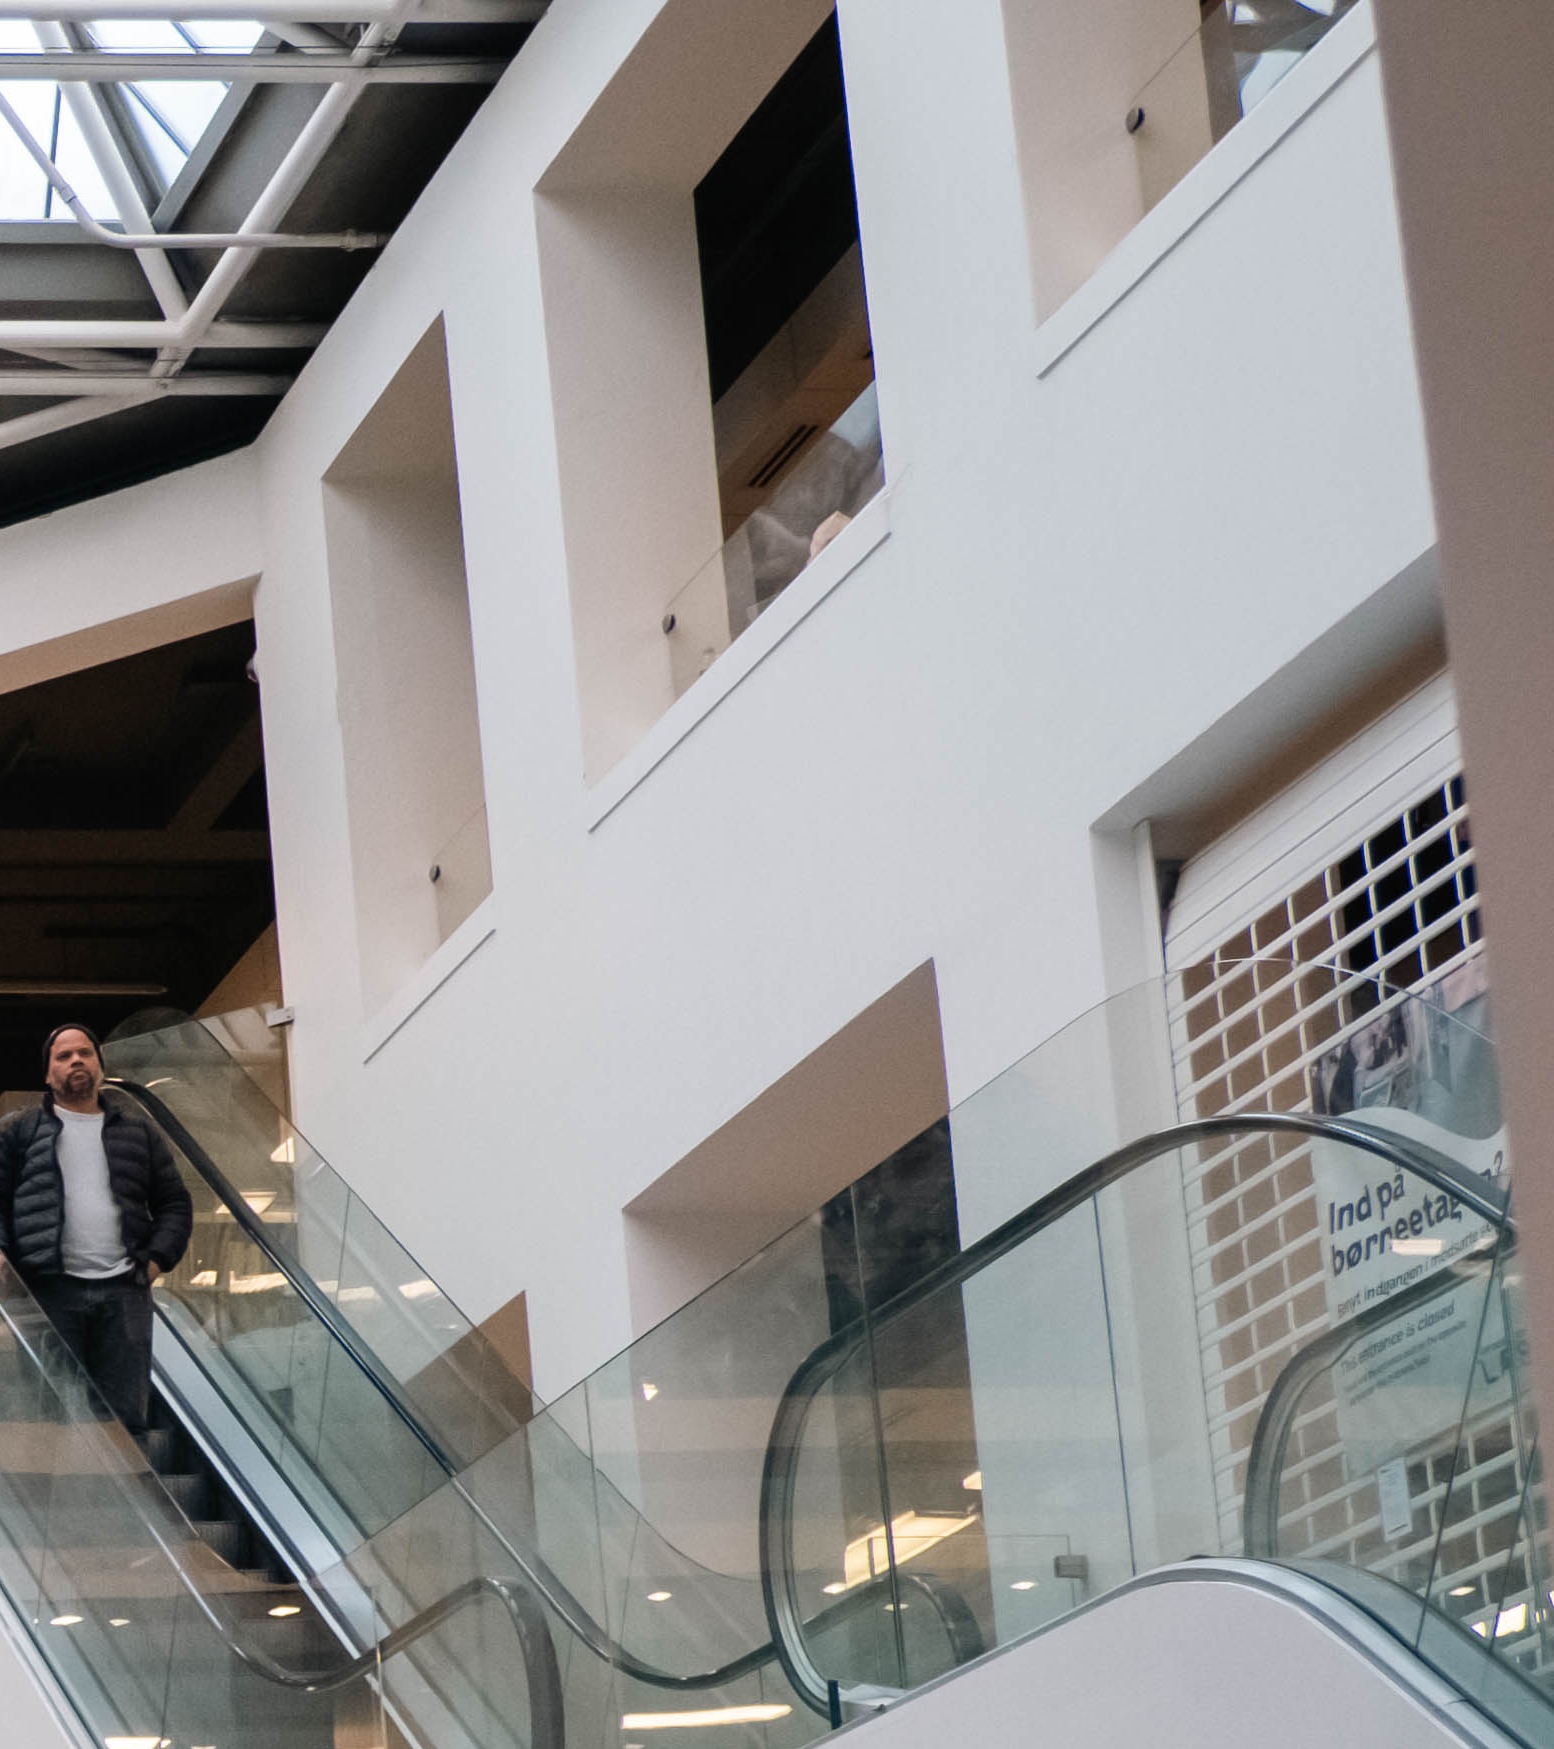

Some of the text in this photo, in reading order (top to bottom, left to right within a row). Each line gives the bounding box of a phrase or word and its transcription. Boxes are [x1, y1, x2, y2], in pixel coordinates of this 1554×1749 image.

[1329, 1166, 1405, 1235] Ind på
[1417, 1299, 1455, 1333] closed
